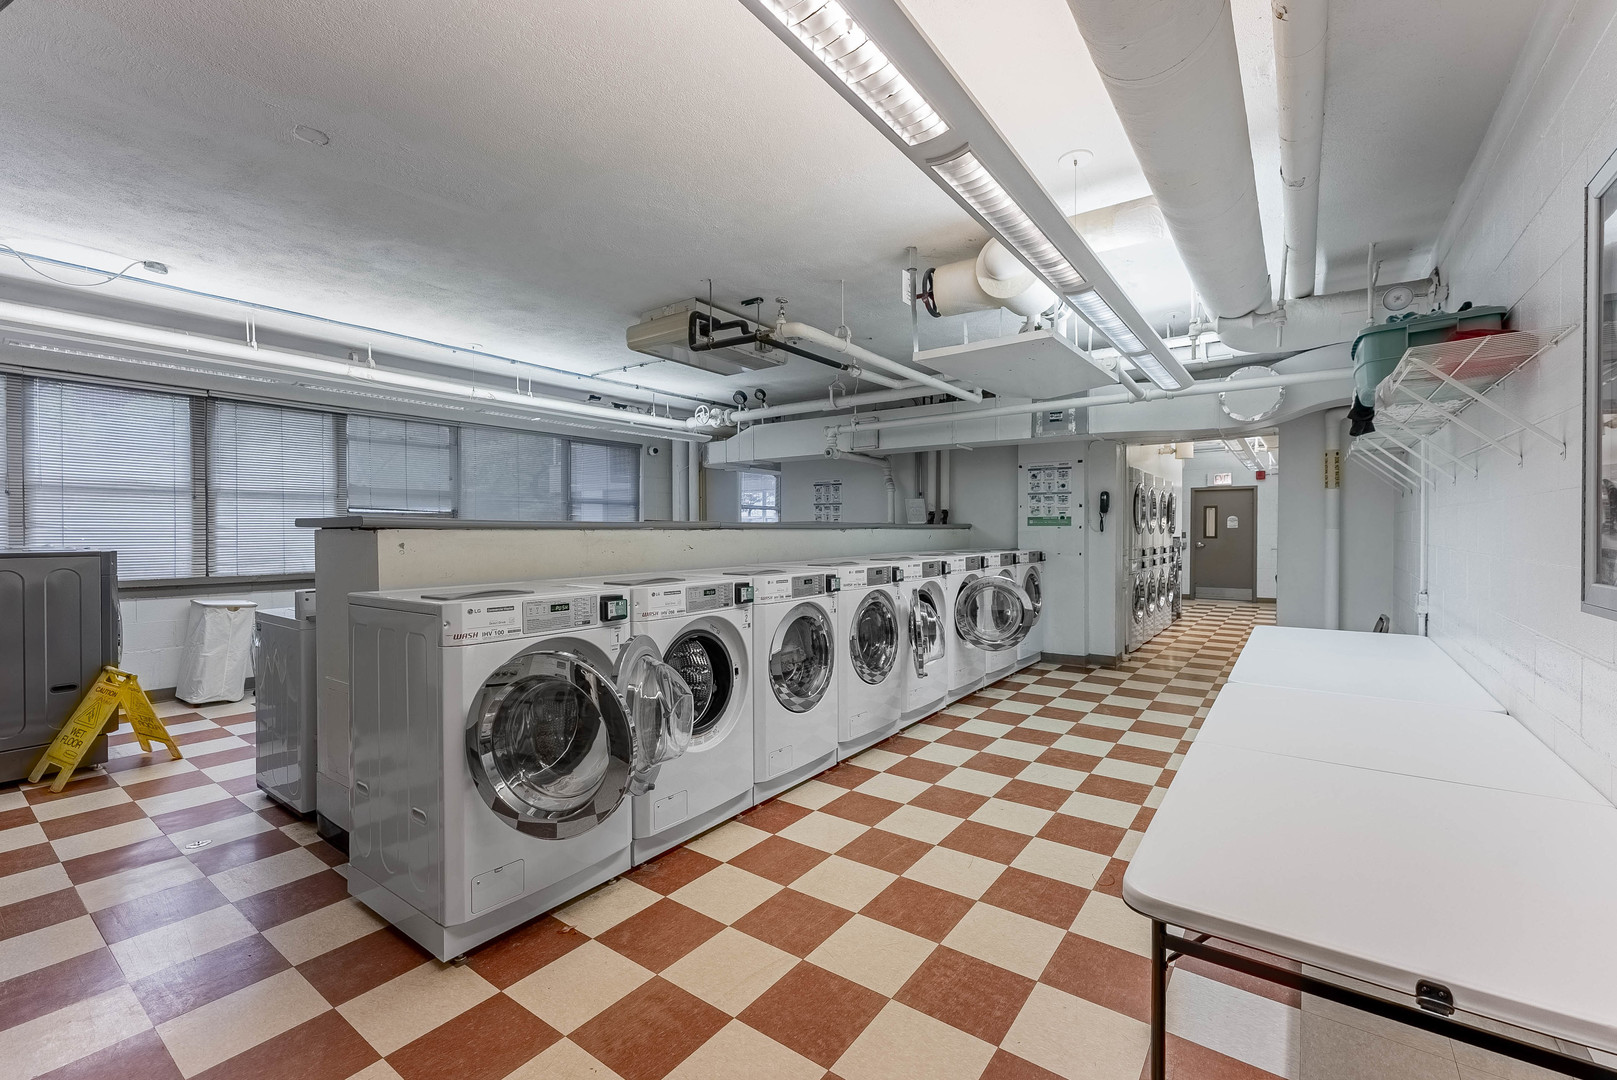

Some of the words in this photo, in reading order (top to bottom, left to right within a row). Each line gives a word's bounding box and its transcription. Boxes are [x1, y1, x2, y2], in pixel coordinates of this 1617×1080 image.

[1214, 474, 1230, 483] EXIT
[453, 631, 479, 640] WASH
[95, 686, 118, 698] CAUTION
[70, 726, 87, 739] WET
[60, 735, 83, 749] FLOOR
